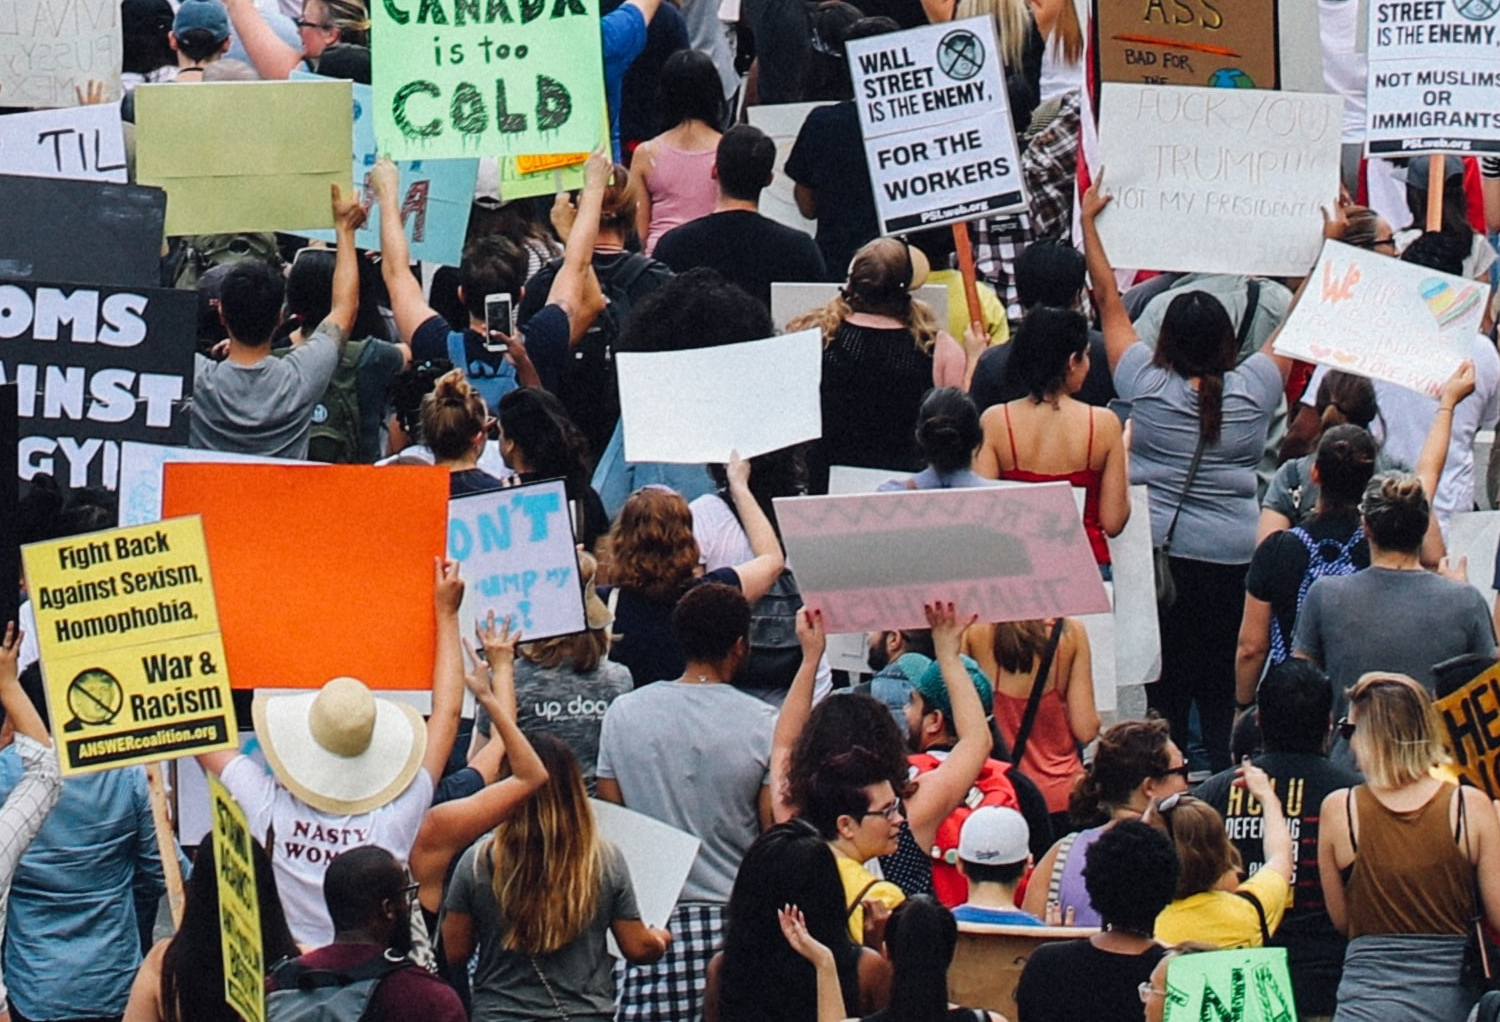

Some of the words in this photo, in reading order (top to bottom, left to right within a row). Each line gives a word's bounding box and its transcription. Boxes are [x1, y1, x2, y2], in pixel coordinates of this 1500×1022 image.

[434, 36, 461, 67] is
[478, 34, 530, 64] too
[858, 48, 916, 75] WALL
[1125, 49, 1158, 66] BAD
[1162, 52, 1193, 71] FOR
[864, 67, 934, 96] STREET
[1375, 74, 1410, 87] NOT
[1423, 90, 1451, 105] OR
[392, 75, 574, 137] COLD
[869, 100, 886, 122] IS
[889, 94, 920, 119] THE
[921, 81, 993, 116] ENEMY,
[1137, 88, 1227, 128] FUCK
[1247, 96, 1330, 142] YOU
[878, 144, 925, 171] FOR
[932, 128, 981, 156] THE
[1402, 138, 1471, 151] PSLweb.org
[882, 156, 1011, 203] WORKERS
[921, 200, 989, 225] PSLweb.org
[58, 542, 109, 572] Fight
[116, 531, 170, 565] Back
[39, 577, 119, 611] Against
[122, 567, 203, 600] Sexism,
[55, 602, 199, 644] Homophobia,
[143, 653, 193, 683] War
[199, 651, 218, 675] &
[131, 684, 223, 723] Racism
[78, 726, 219, 761] ANSWERcoalition.org
[292, 820, 368, 845] NASTY
